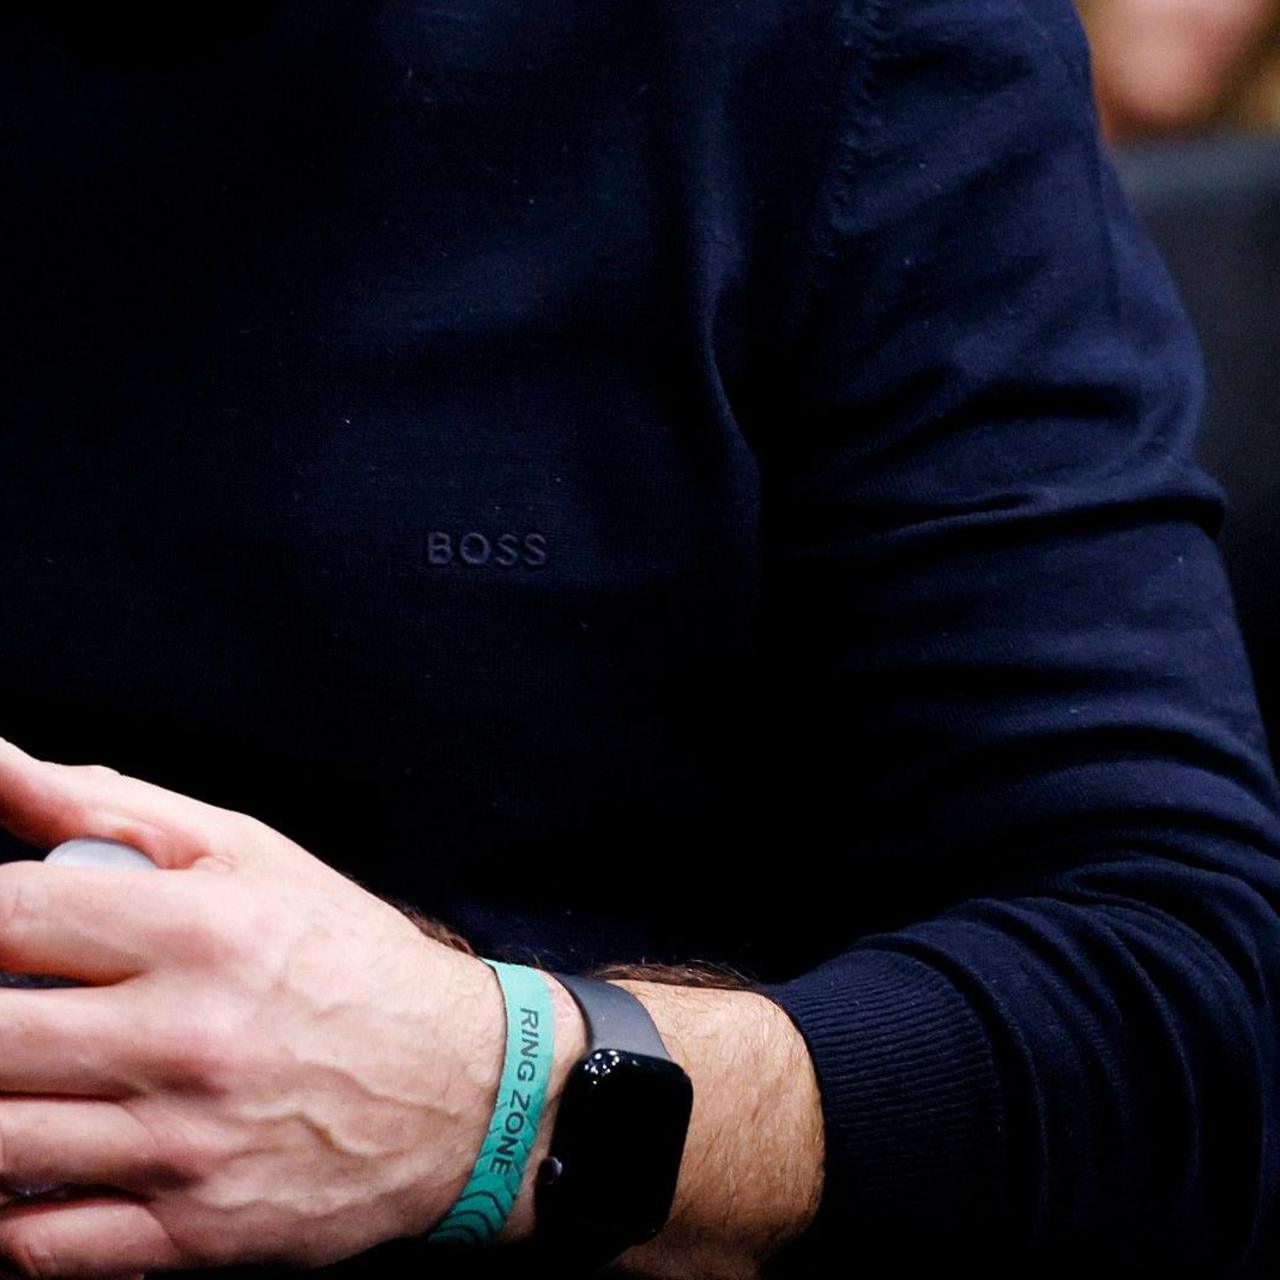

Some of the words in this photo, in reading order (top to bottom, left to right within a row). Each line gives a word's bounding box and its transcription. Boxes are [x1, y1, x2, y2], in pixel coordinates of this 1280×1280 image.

[427, 532, 547, 566] BOSS
[517, 1007, 539, 1082] RING
[489, 1089, 532, 1175] ZONE
